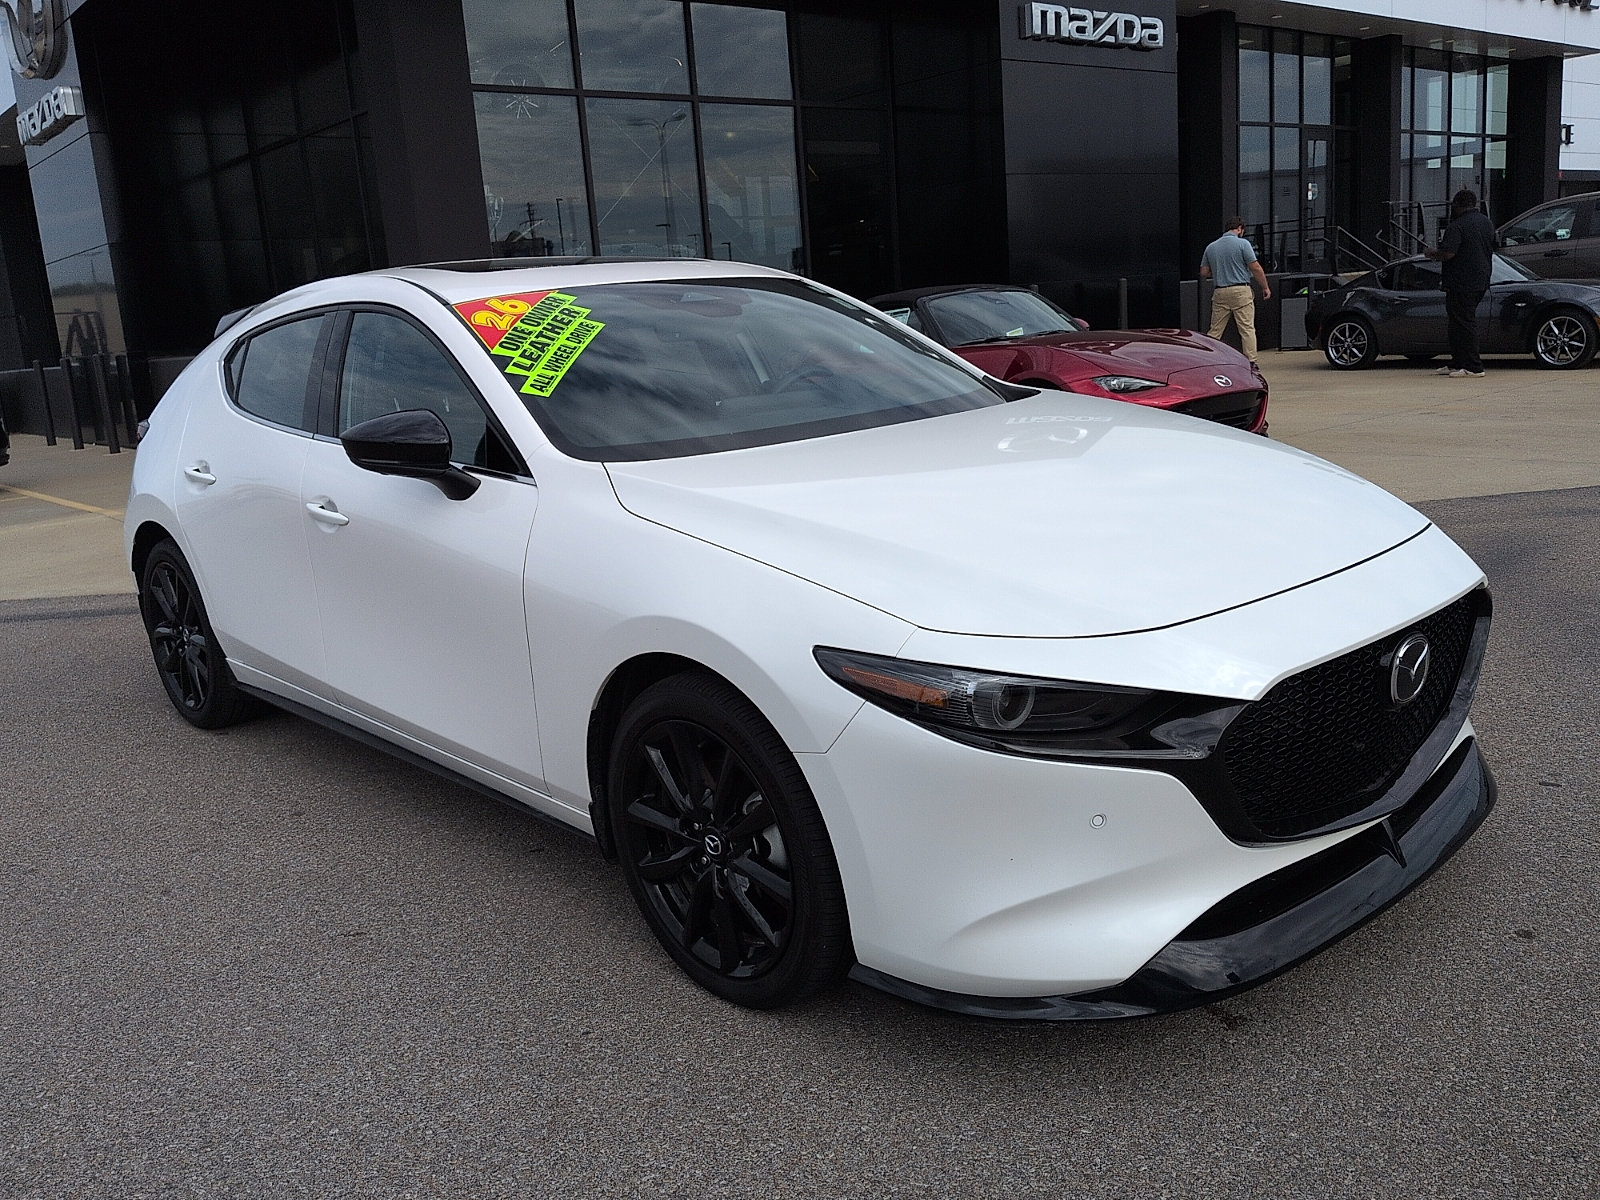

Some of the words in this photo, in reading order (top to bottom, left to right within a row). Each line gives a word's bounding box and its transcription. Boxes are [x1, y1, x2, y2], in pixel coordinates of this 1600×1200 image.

[1027, 2, 1164, 48] mazda
[471, 298, 533, 331] 26
[498, 326, 533, 352] ONE
[520, 296, 568, 328] OWNER
[511, 307, 581, 372] LEATHER
[565, 321, 595, 345] DRIVE
[541, 343, 577, 373] WHEEL
[529, 374, 557, 394] ALL
